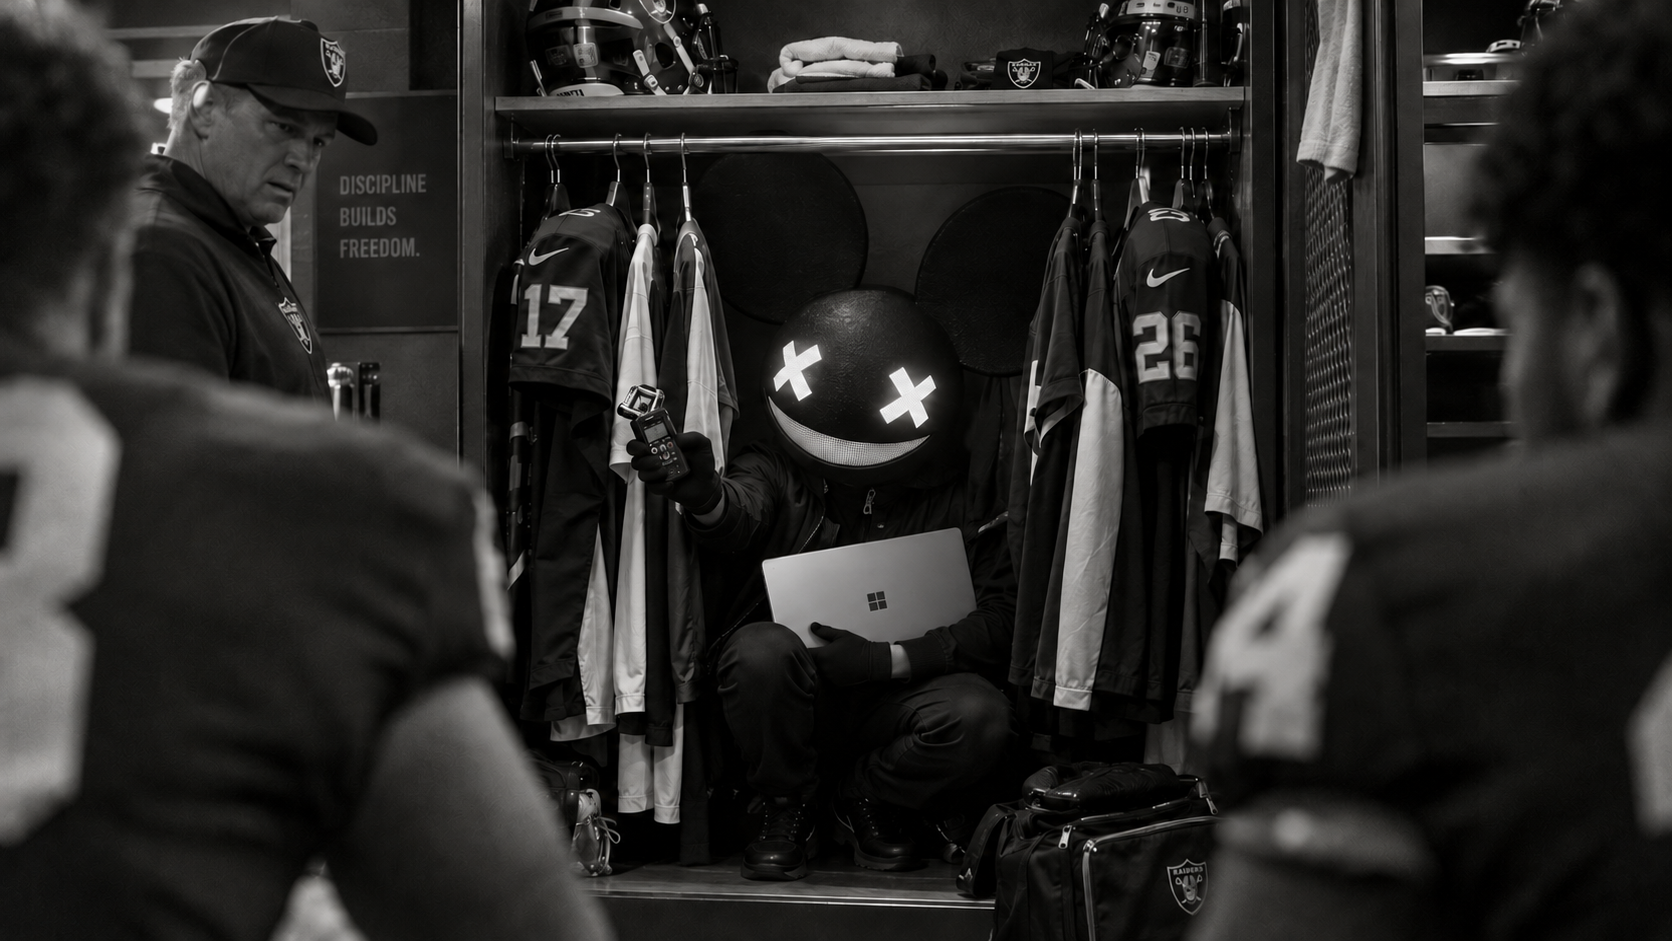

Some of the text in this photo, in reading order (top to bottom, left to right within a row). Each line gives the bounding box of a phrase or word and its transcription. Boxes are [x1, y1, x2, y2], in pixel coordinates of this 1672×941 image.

[340, 174, 427, 195] DISCIPLINE
[340, 206, 397, 226] BUILDS
[340, 237, 420, 258] FREEDOM.
[520, 283, 590, 350] 17
[1132, 309, 1202, 385] 26
